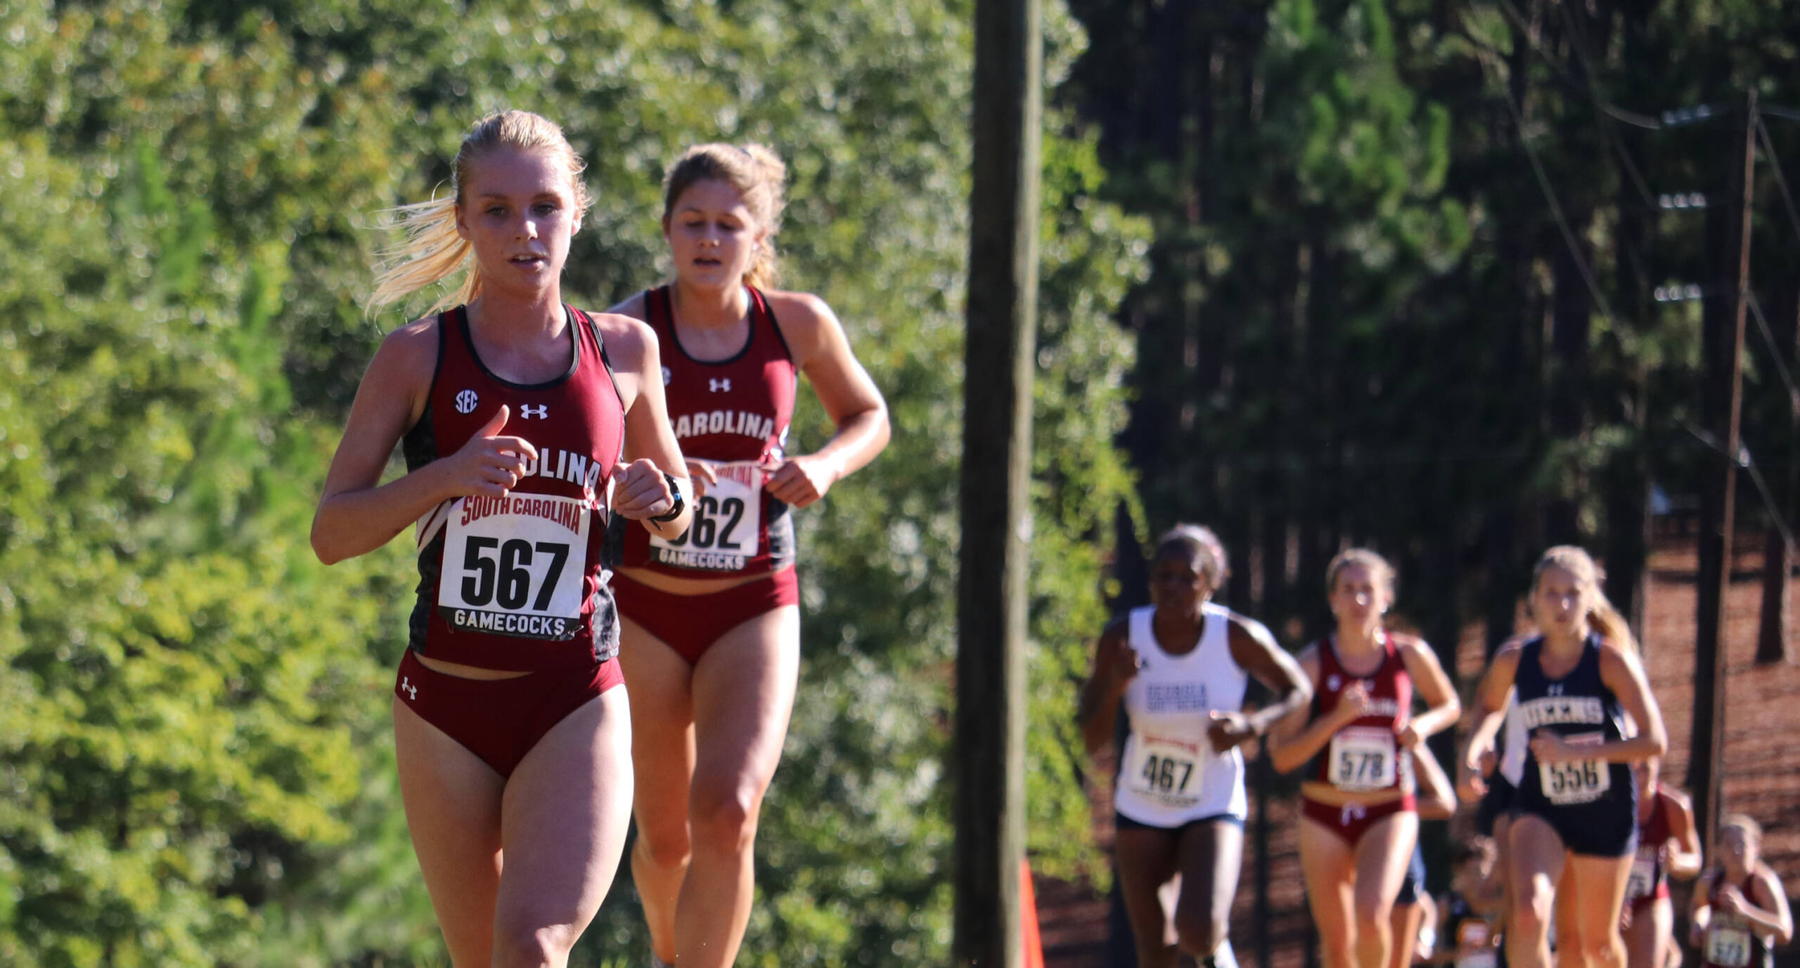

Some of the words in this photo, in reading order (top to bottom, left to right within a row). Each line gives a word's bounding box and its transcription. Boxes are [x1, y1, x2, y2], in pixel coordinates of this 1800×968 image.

[454, 389, 478, 414] SEC
[670, 410, 775, 440] AROLINA
[461, 495, 510, 527] SOUTH
[513, 498, 582, 535] CAROLINA
[460, 535, 570, 612] 567
[659, 549, 745, 570] GAMECOCKS
[454, 609, 566, 636] GAMECOCKS
[1142, 754, 1194, 793] 467
[1340, 751, 1385, 779] 578
